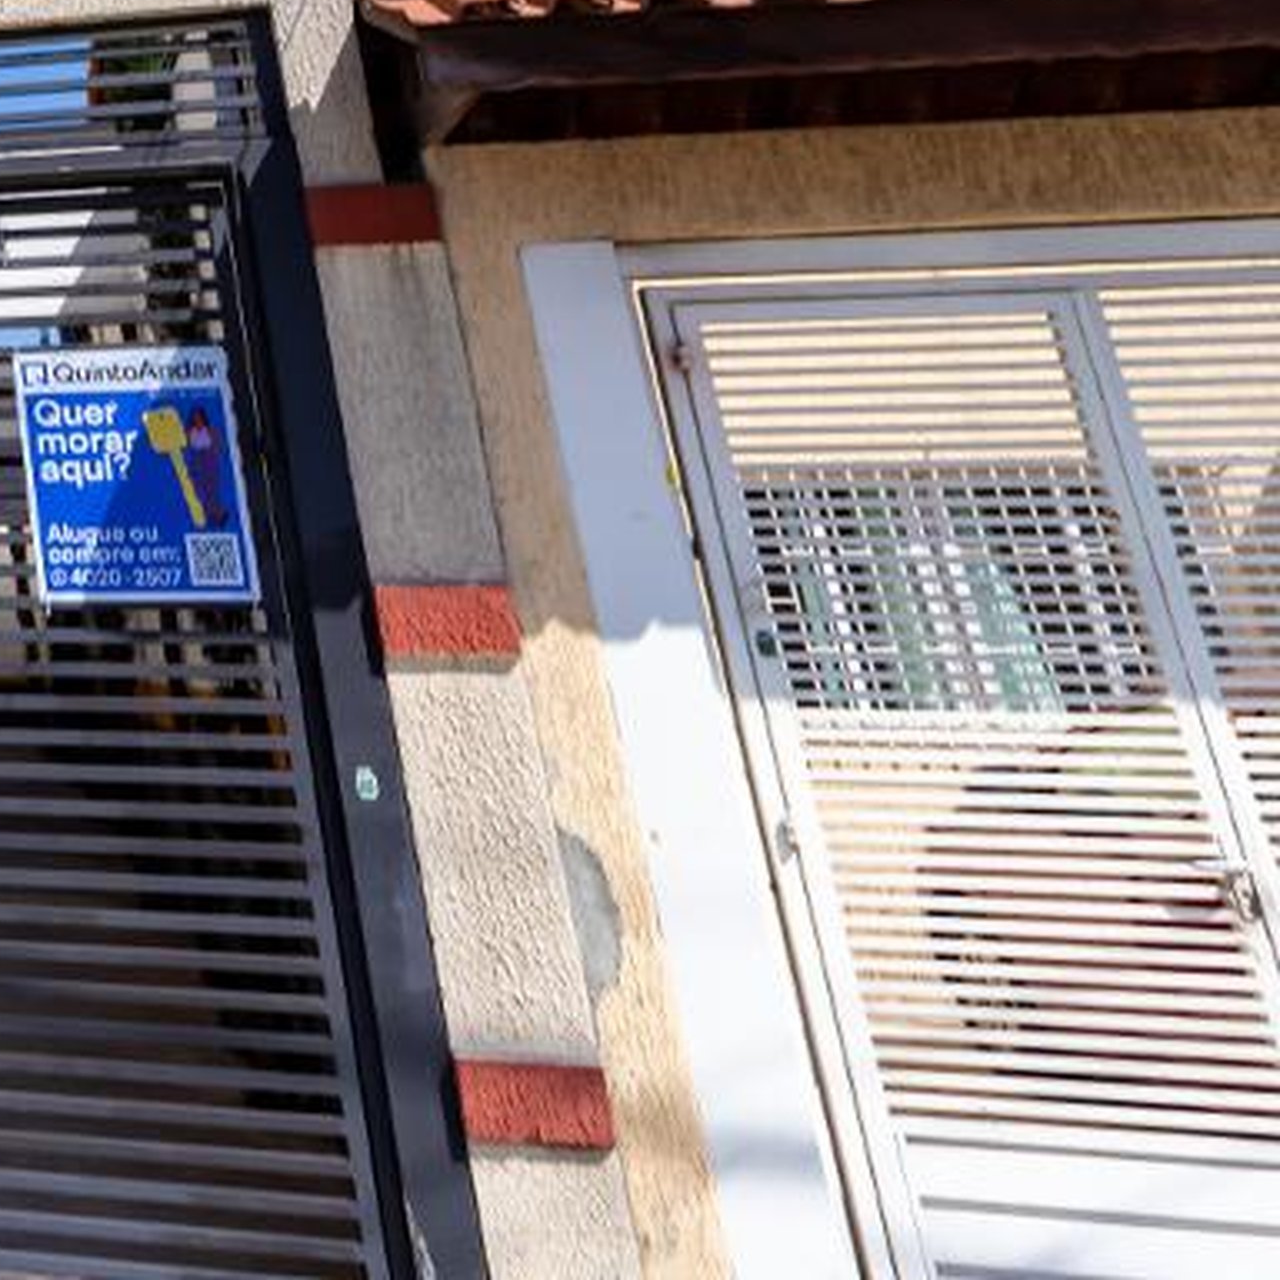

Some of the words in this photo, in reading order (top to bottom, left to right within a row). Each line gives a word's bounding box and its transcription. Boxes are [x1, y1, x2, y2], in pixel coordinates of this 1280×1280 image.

[52, 358, 217, 383] QuintoAndar
[34, 399, 118, 426] Quer
[39, 430, 138, 454] morar
[40, 453, 132, 489] aqui?
[46, 522, 126, 548] Alugue
[130, 524, 159, 543] ou
[48, 546, 135, 570] compre
